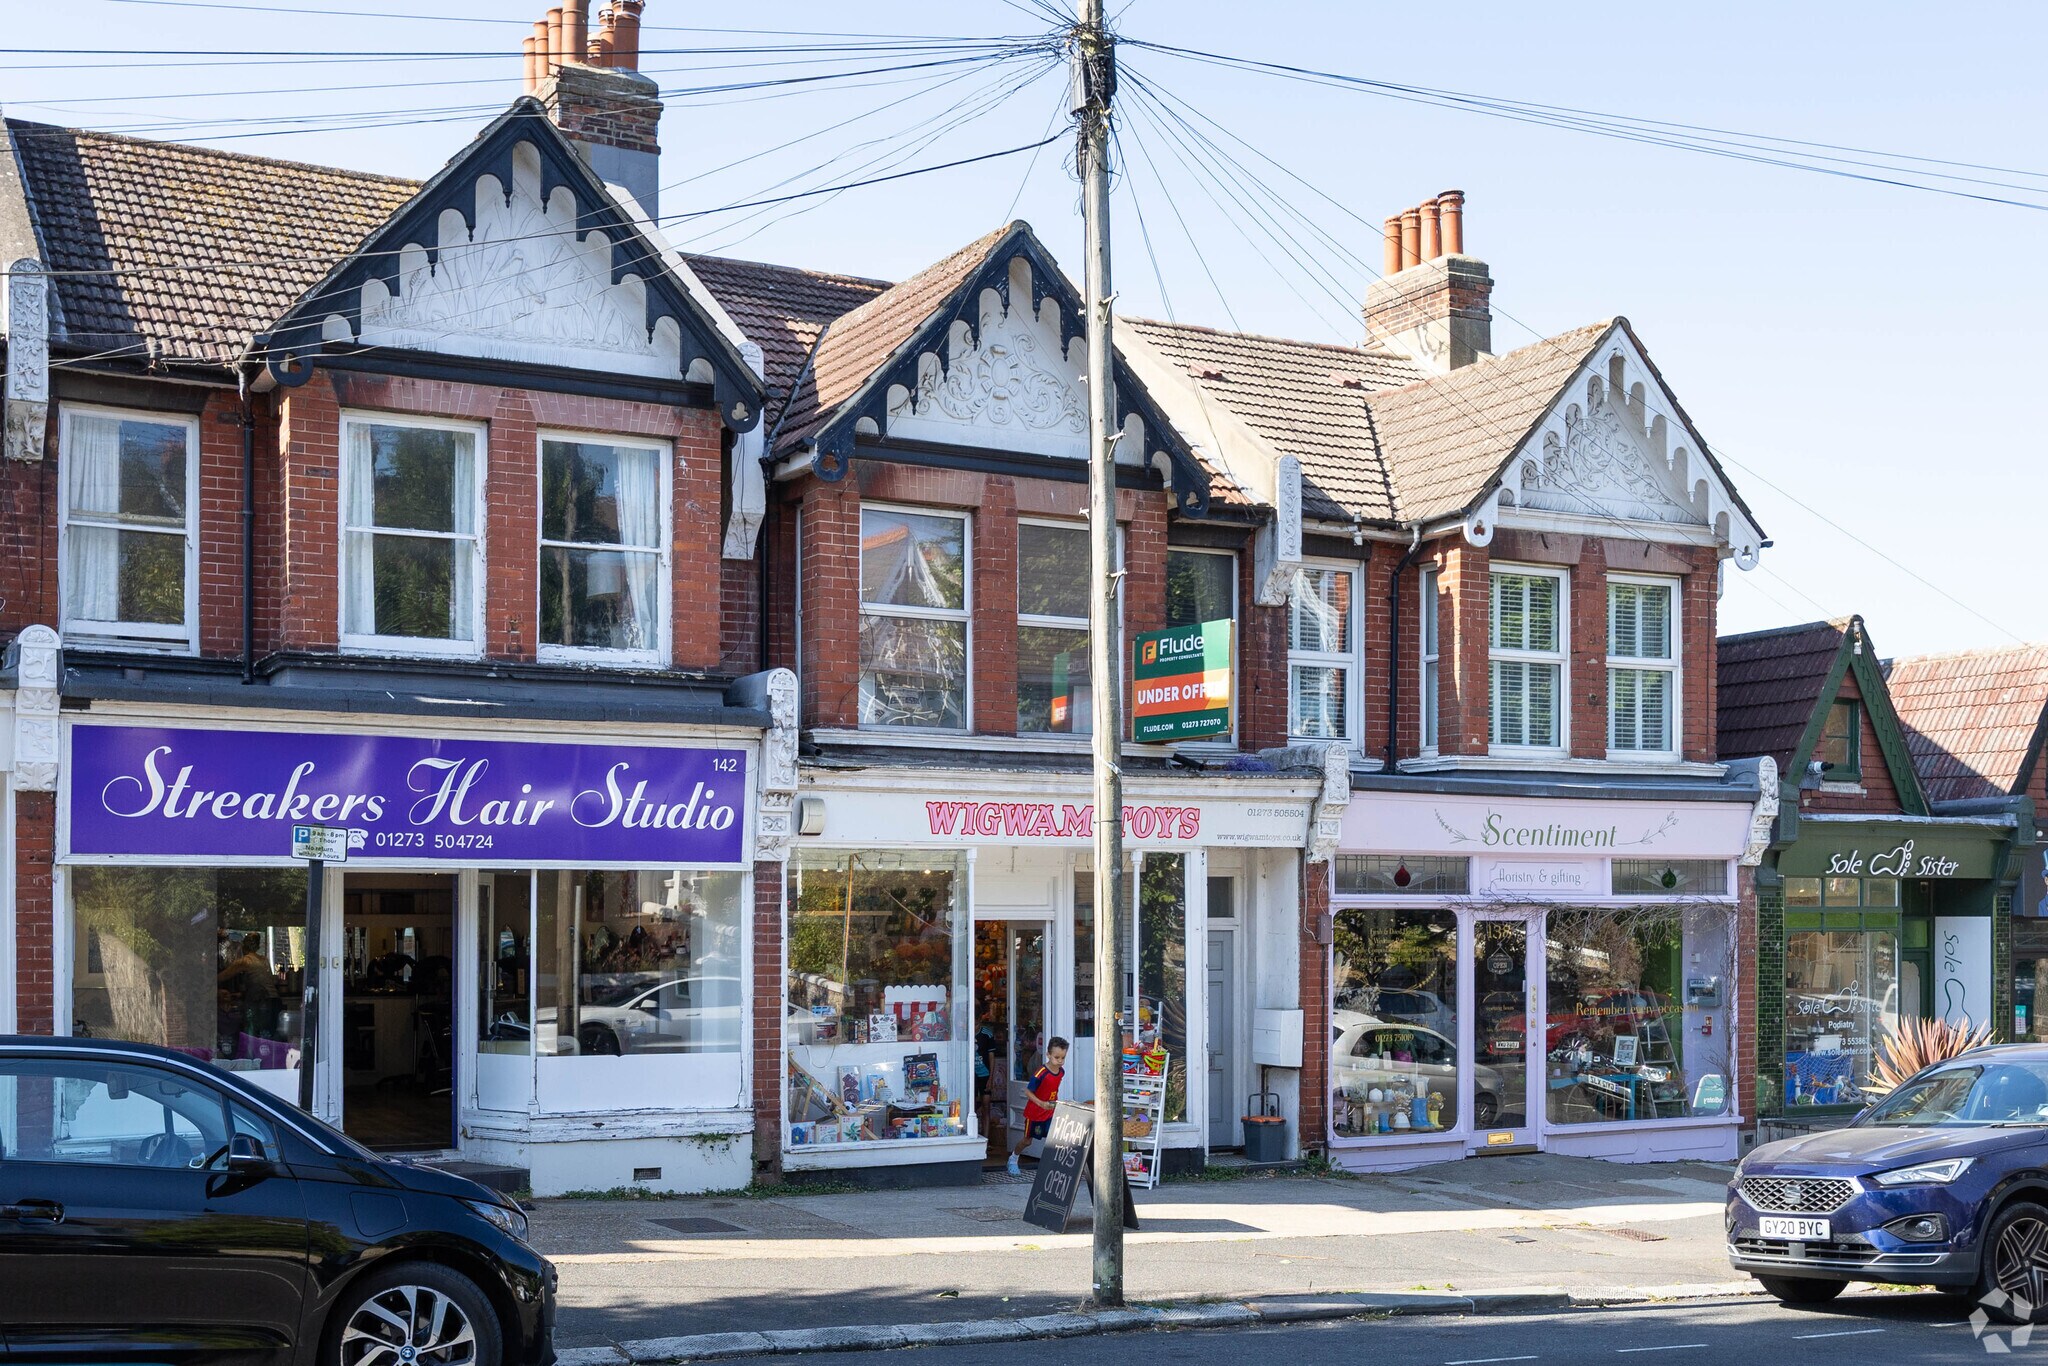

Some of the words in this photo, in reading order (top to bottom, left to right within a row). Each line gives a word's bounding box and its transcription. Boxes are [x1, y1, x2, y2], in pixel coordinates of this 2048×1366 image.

[1159, 634, 1205, 655] Flude
[1159, 655, 1178, 663] PROPERTY
[1138, 686, 1179, 704] UNDER
[1143, 723, 1174, 733] FLUDE.COM
[1181, 719, 1199, 729] 01273
[1199, 718, 1221, 727] 727070
[712, 757, 738, 773] 142
[101, 745, 386, 822] Streakers
[406, 757, 554, 828] Hair
[570, 762, 736, 832] Studio
[1247, 808, 1273, 817] 01273
[299, 830, 308, 842] P
[1216, 833, 1302, 842] www.wigwamtoys.co.uk
[1484, 813, 1617, 848] Scentiment
[375, 832, 425, 847] 01273
[433, 834, 494, 849] 504724
[1826, 849, 1863, 875] Sole
[1915, 854, 1960, 877] Sister
[1500, 867, 1535, 886] floristry
[1538, 868, 1547, 883] &
[1551, 868, 1581, 887] gifting
[1487, 923, 1512, 939] 138
[1943, 930, 1962, 973] Sole
[1492, 961, 1508, 969] OPEN
[1576, 1002, 1626, 1016] Remember
[1657, 1003, 1699, 1015] occason
[1796, 999, 1820, 1015] Sole
[1828, 1020, 1855, 1030] Podiatry
[1375, 1034, 1392, 1042] 01273
[1053, 1114, 1090, 1148] WIGWAM
[1053, 1144, 1078, 1168] TOYS
[1044, 1169, 1072, 1202] OPEN
[1765, 1220, 1795, 1235] GY20
[1798, 1220, 1824, 1236] BYC
